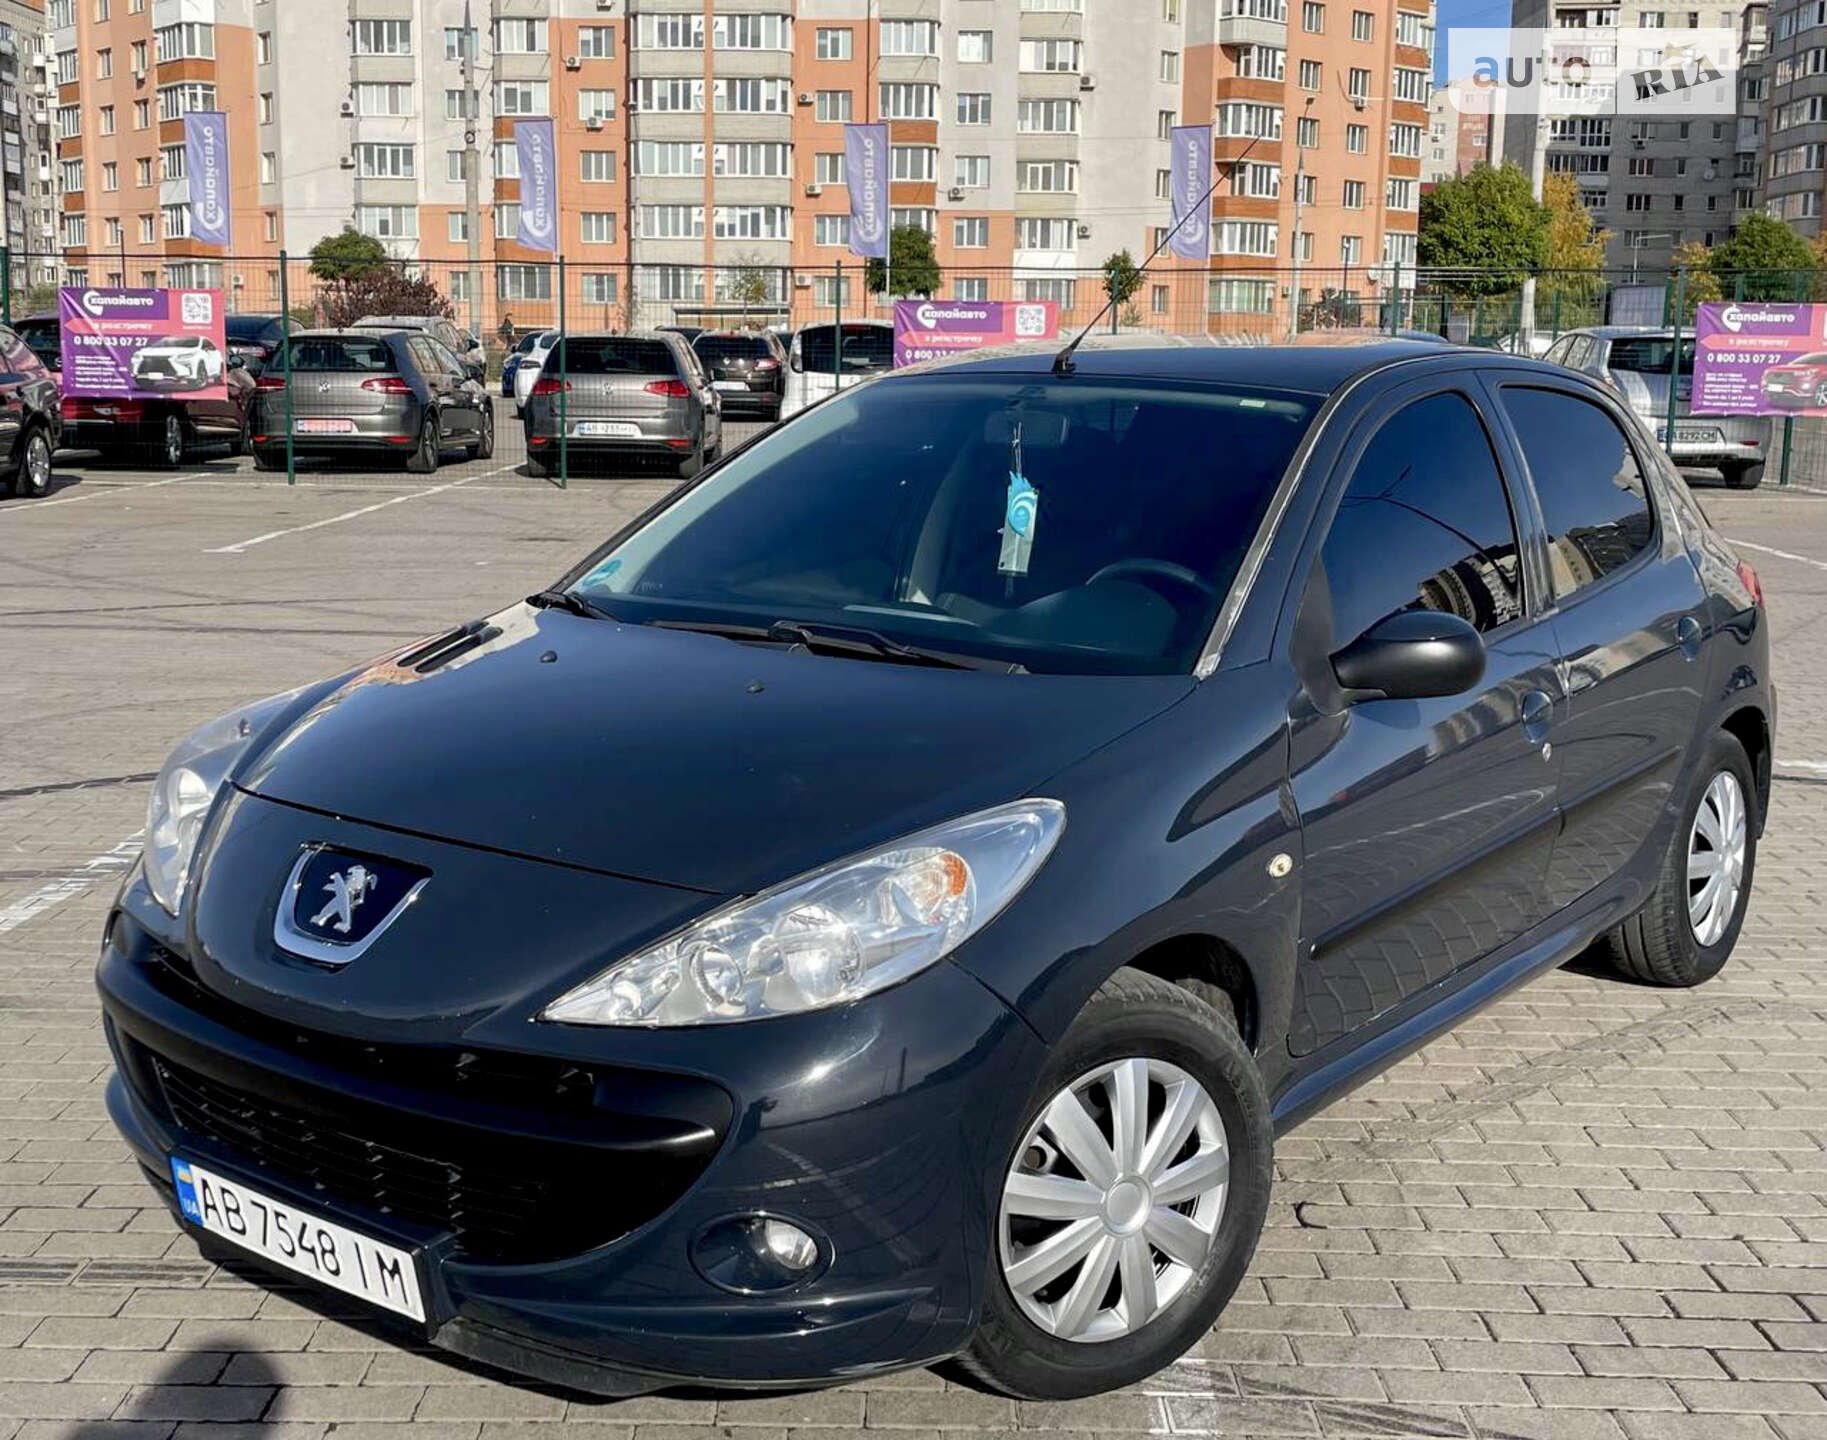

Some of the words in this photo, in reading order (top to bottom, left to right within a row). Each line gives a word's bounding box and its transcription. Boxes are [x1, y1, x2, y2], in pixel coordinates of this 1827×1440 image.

[74, 336, 81, 345] 0
[120, 337, 133, 346] 07
[135, 337, 148, 346] 27
[905, 350, 912, 359] 0
[914, 350, 933, 359] 800
[1707, 353, 1714, 362] 0
[1716, 353, 1735, 362] 800
[1738, 354, 1751, 363] 33
[1753, 354, 1767, 363] 07
[1768, 354, 1781, 364] 27
[201, 1177, 246, 1236] AB
[250, 1201, 341, 1277] 7548
[355, 1242, 409, 1306] IM
